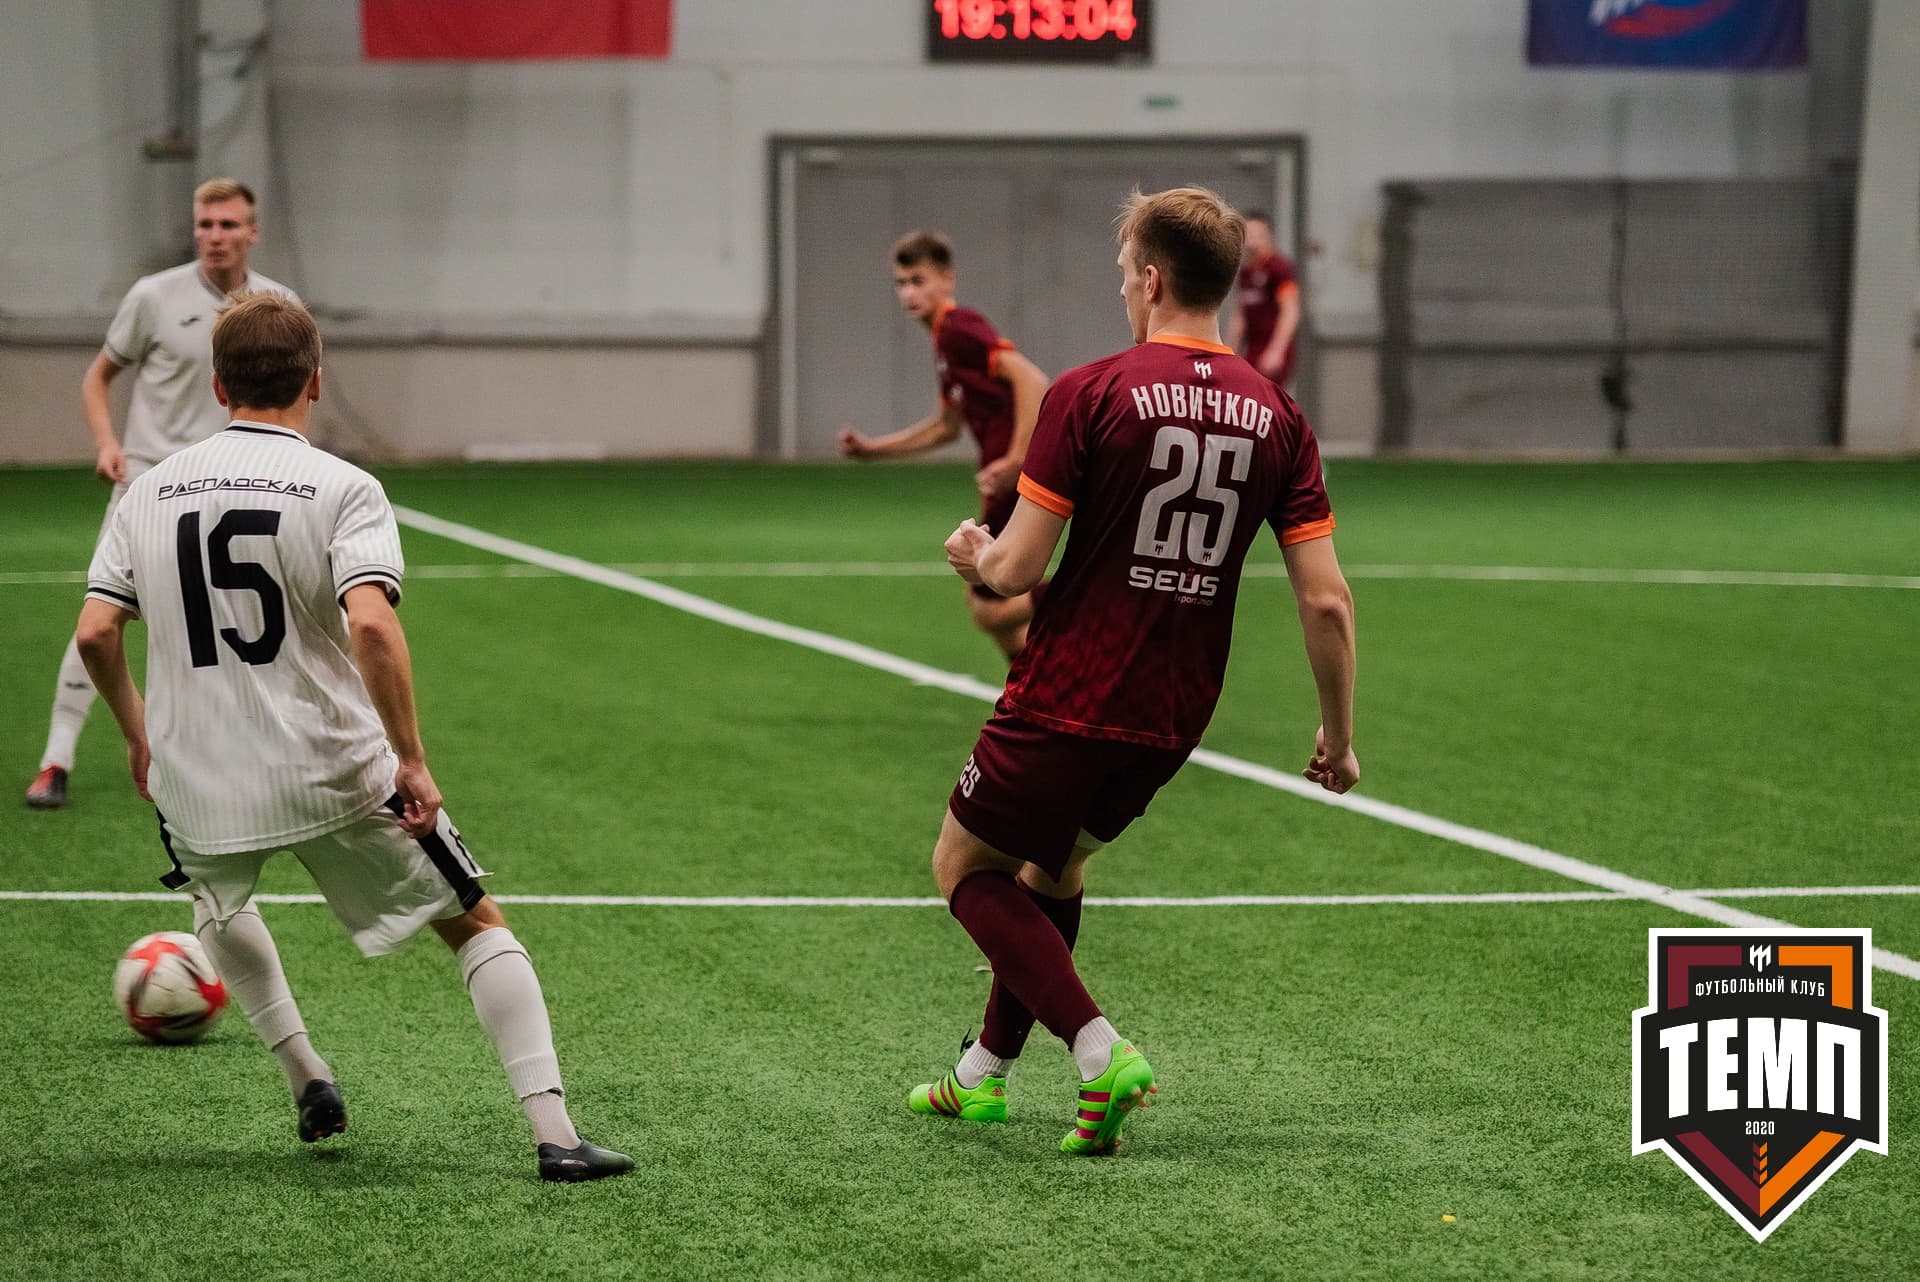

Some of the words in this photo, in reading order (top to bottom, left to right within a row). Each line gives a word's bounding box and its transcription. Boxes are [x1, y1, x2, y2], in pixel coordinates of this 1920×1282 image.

[1131, 382, 1273, 440] НОВИЧКОВ
[157, 478, 317, 501] РАСПАДСКАЯ
[1133, 425, 1254, 567] 25
[177, 509, 286, 668] 15
